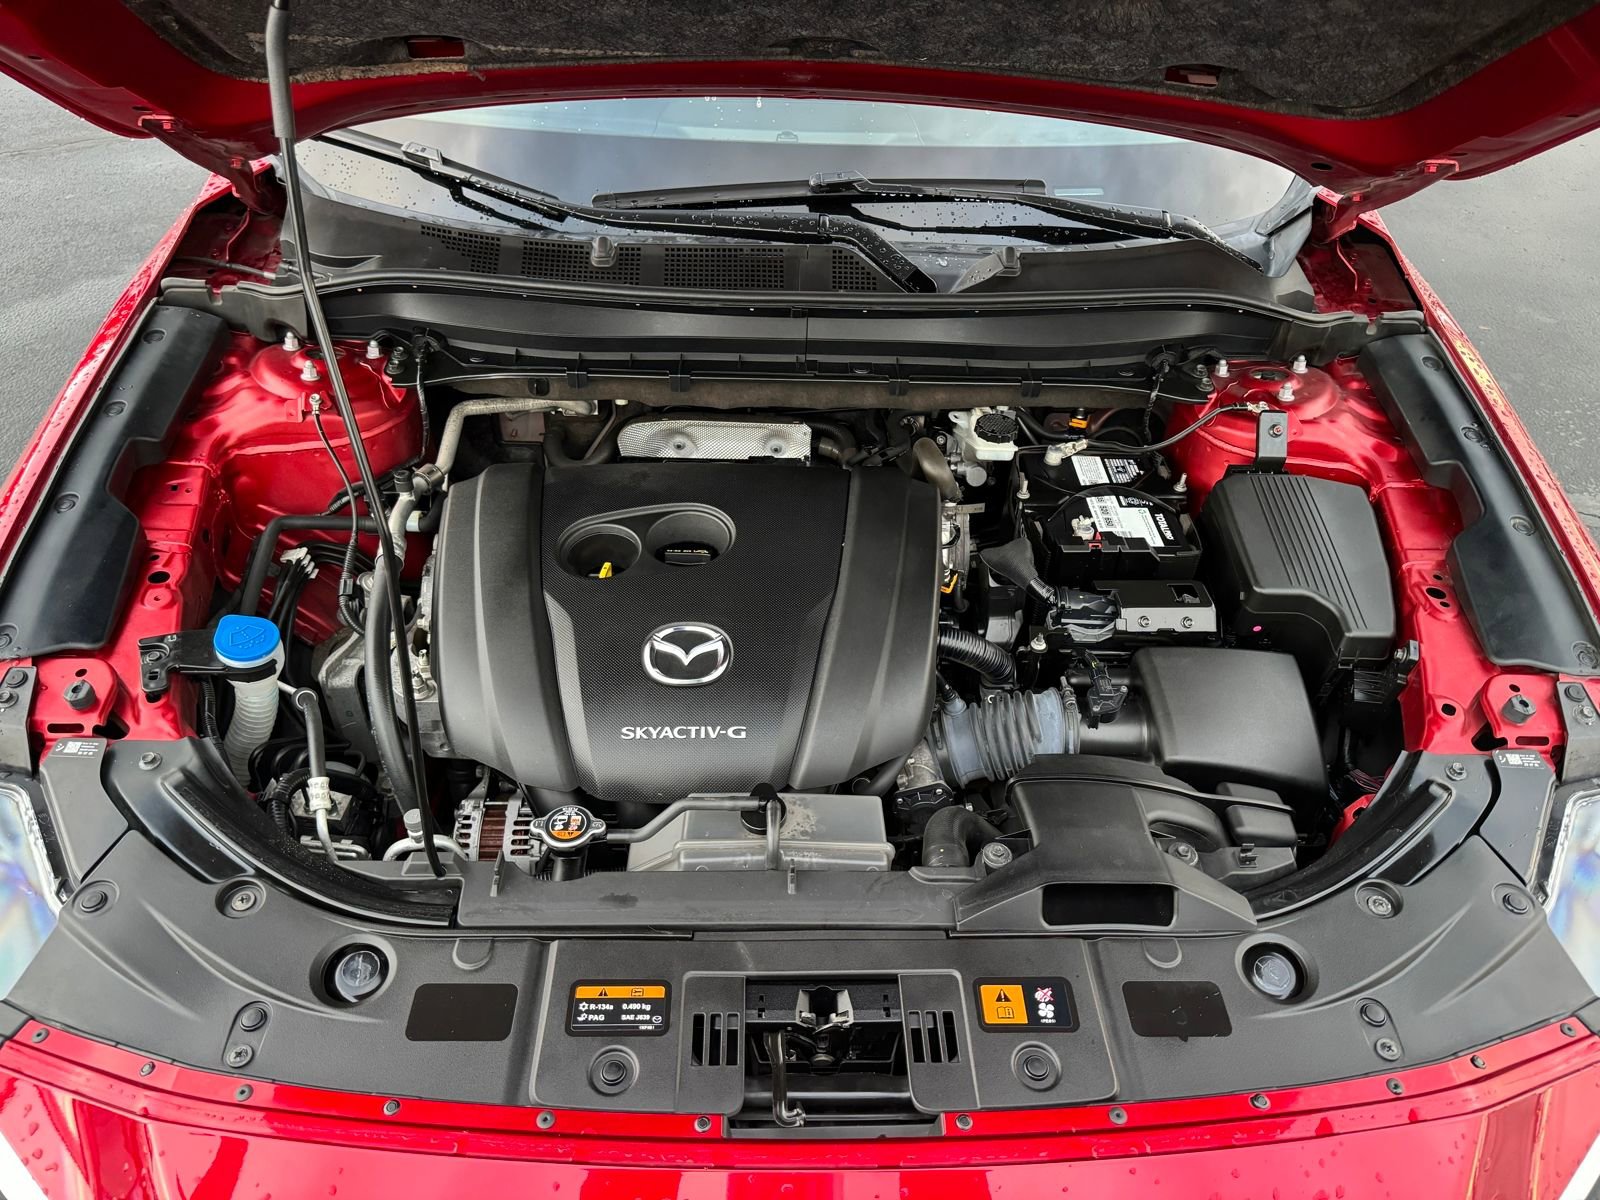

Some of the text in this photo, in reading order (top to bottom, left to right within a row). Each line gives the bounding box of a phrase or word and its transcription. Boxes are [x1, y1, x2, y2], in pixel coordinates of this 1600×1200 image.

[621, 726, 747, 740] SKYACTIV-G
[589, 1003, 614, 1011] R-134a
[641, 1003, 651, 1011] kg
